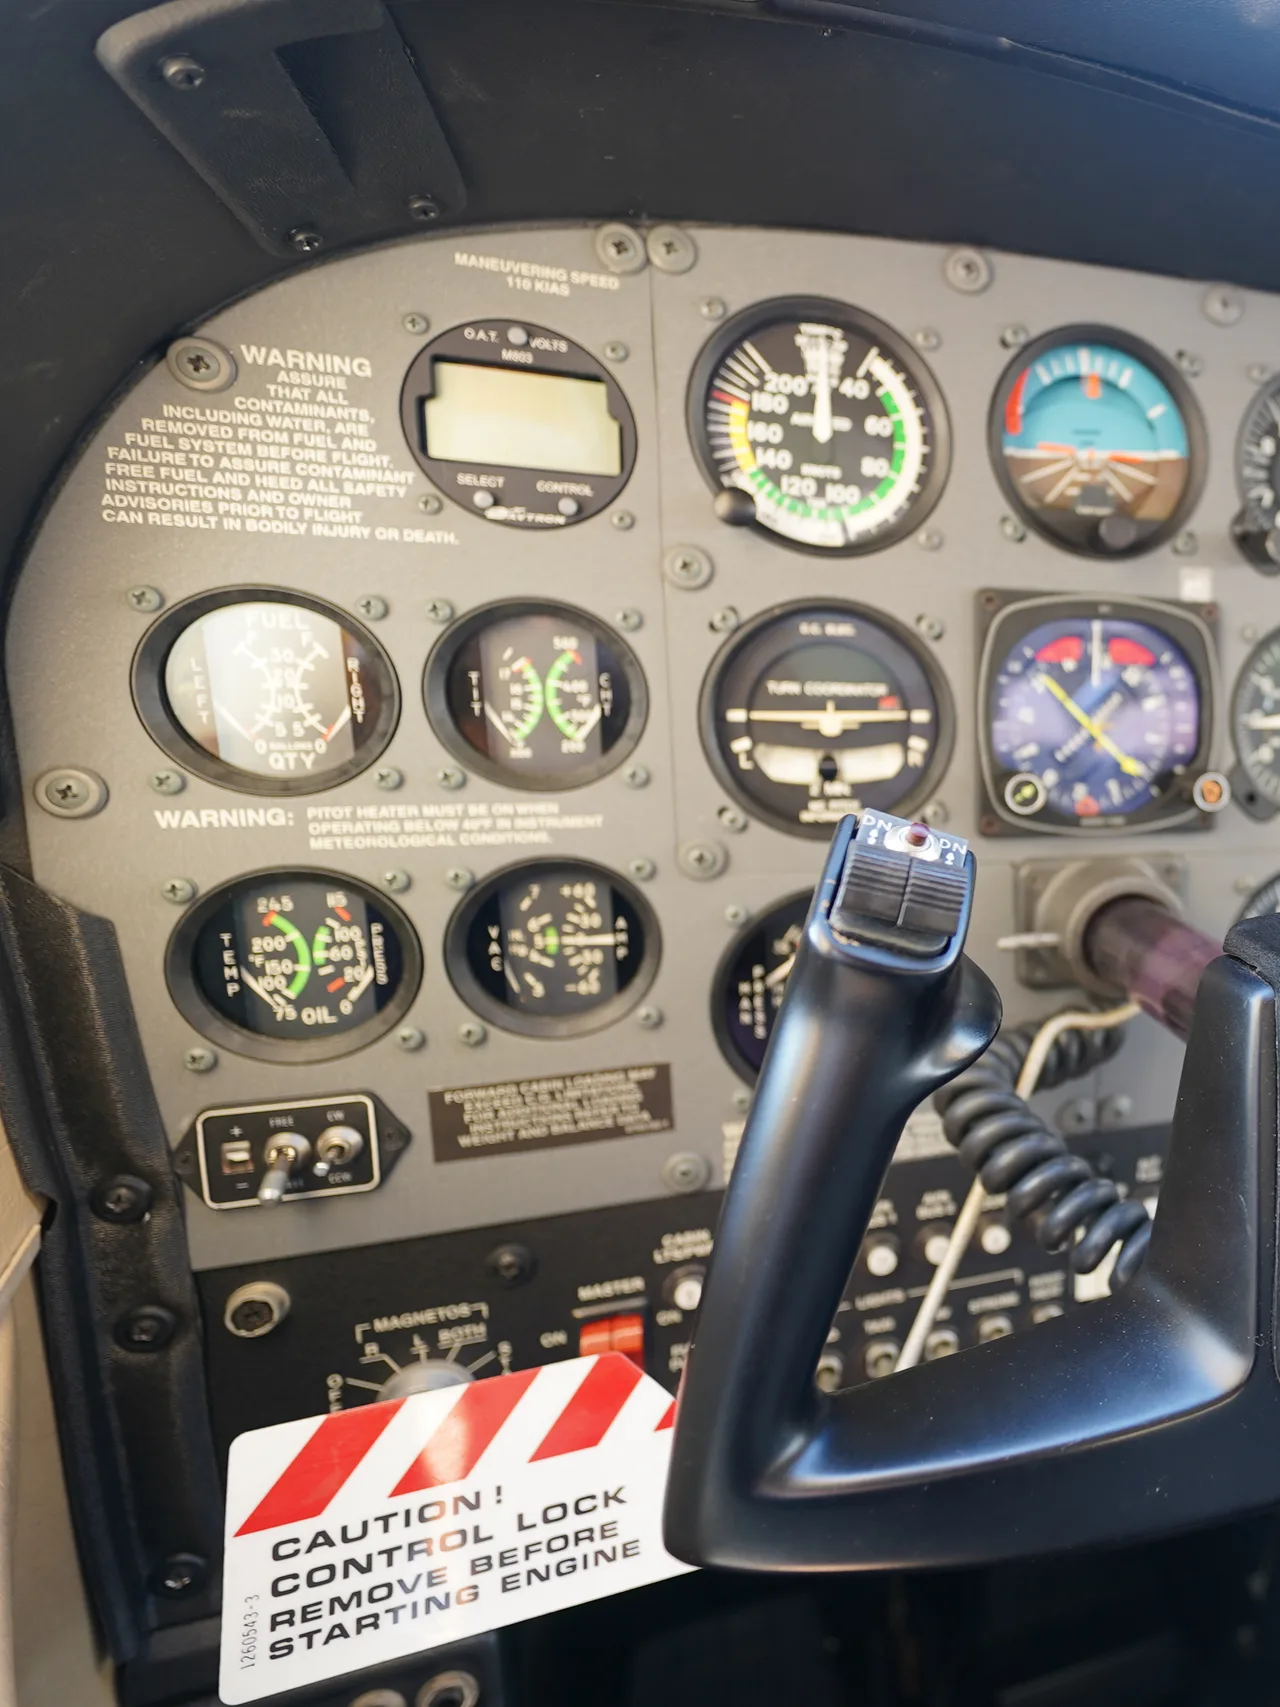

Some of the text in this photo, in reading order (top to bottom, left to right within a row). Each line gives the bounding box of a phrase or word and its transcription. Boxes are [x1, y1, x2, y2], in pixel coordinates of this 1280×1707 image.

[454, 252, 620, 290] MANEUVERING SPEED
[506, 276, 570, 297] 110 KIAS
[529, 337, 568, 353] VOLTS
[240, 344, 372, 378] WARNING
[277, 370, 347, 390] ASSURE
[764, 373, 808, 396] 200
[839, 377, 870, 399] 40
[266, 384, 349, 405] THAT ALL
[162, 404, 369, 437] INCLUDING WATER, ARE
[234, 396, 375, 424] CONTAMINANTS,
[141, 417, 377, 452] REMOVED FROM FUEL AND
[124, 433, 174, 449] FUEL
[178, 437, 251, 457] SYSTEM
[256, 444, 327, 464] BEFORE
[756, 448, 793, 470] 140
[107, 446, 416, 485] FAILURE TO ASSURE CONTAMINANT
[105, 462, 408, 498] FREE FUEL AND HEED ALL SAFETY
[457, 472, 505, 488] SELECT
[536, 480, 594, 497] CONTROL
[781, 475, 817, 496] 120
[105, 479, 351, 509] INSTRUCTIONS AND OWNER
[825, 483, 861, 504] 100
[101, 493, 362, 524] ADVISORIES PRIOR TO FLIGHT
[102, 510, 144, 525] CAN
[148, 512, 218, 529] RESULT
[223, 518, 241, 531] IN
[246, 519, 307, 536] BODILY
[312, 523, 371, 540] INJURY
[375, 527, 399, 541] OR
[244, 611, 310, 629] FUEL
[191, 657, 210, 724] LEFT
[347, 657, 365, 723] RIGHT
[269, 752, 316, 770] QTY
[738, 751, 754, 770] L
[154, 807, 295, 829] WARNING:
[307, 806, 353, 820] PITOT
[357, 804, 419, 818] HEATER
[422, 803, 465, 817] MUST
[308, 820, 401, 835] OPERATING
[403, 818, 460, 833] BELOW
[862, 814, 893, 831] DN
[309, 833, 457, 850] METEOROLOGICAL
[939, 838, 968, 855] DN
[257, 896, 294, 913] 245
[252, 935, 287, 953] 200
[334, 926, 362, 942] 100
[219, 932, 240, 997] TEMP
[265, 959, 294, 975] 150
[301, 1006, 338, 1025] OIL
[340, 999, 353, 1015] 0
[269, 1115, 295, 1128] FREE
[457, 1130, 515, 1148] WEIGHT
[577, 1276, 646, 1301] MASTER
[373, 1302, 471, 1333] MAGNETOS
[438, 1321, 487, 1342] BOTH
[539, 1329, 568, 1348] ON
[271, 1486, 627, 1598] CONTROL LOCK
[270, 1520, 619, 1633] REMOVE BEFORE
[269, 1539, 641, 1661] STARTING ENGINE
[241, 1594, 260, 1671] 1260543-3
